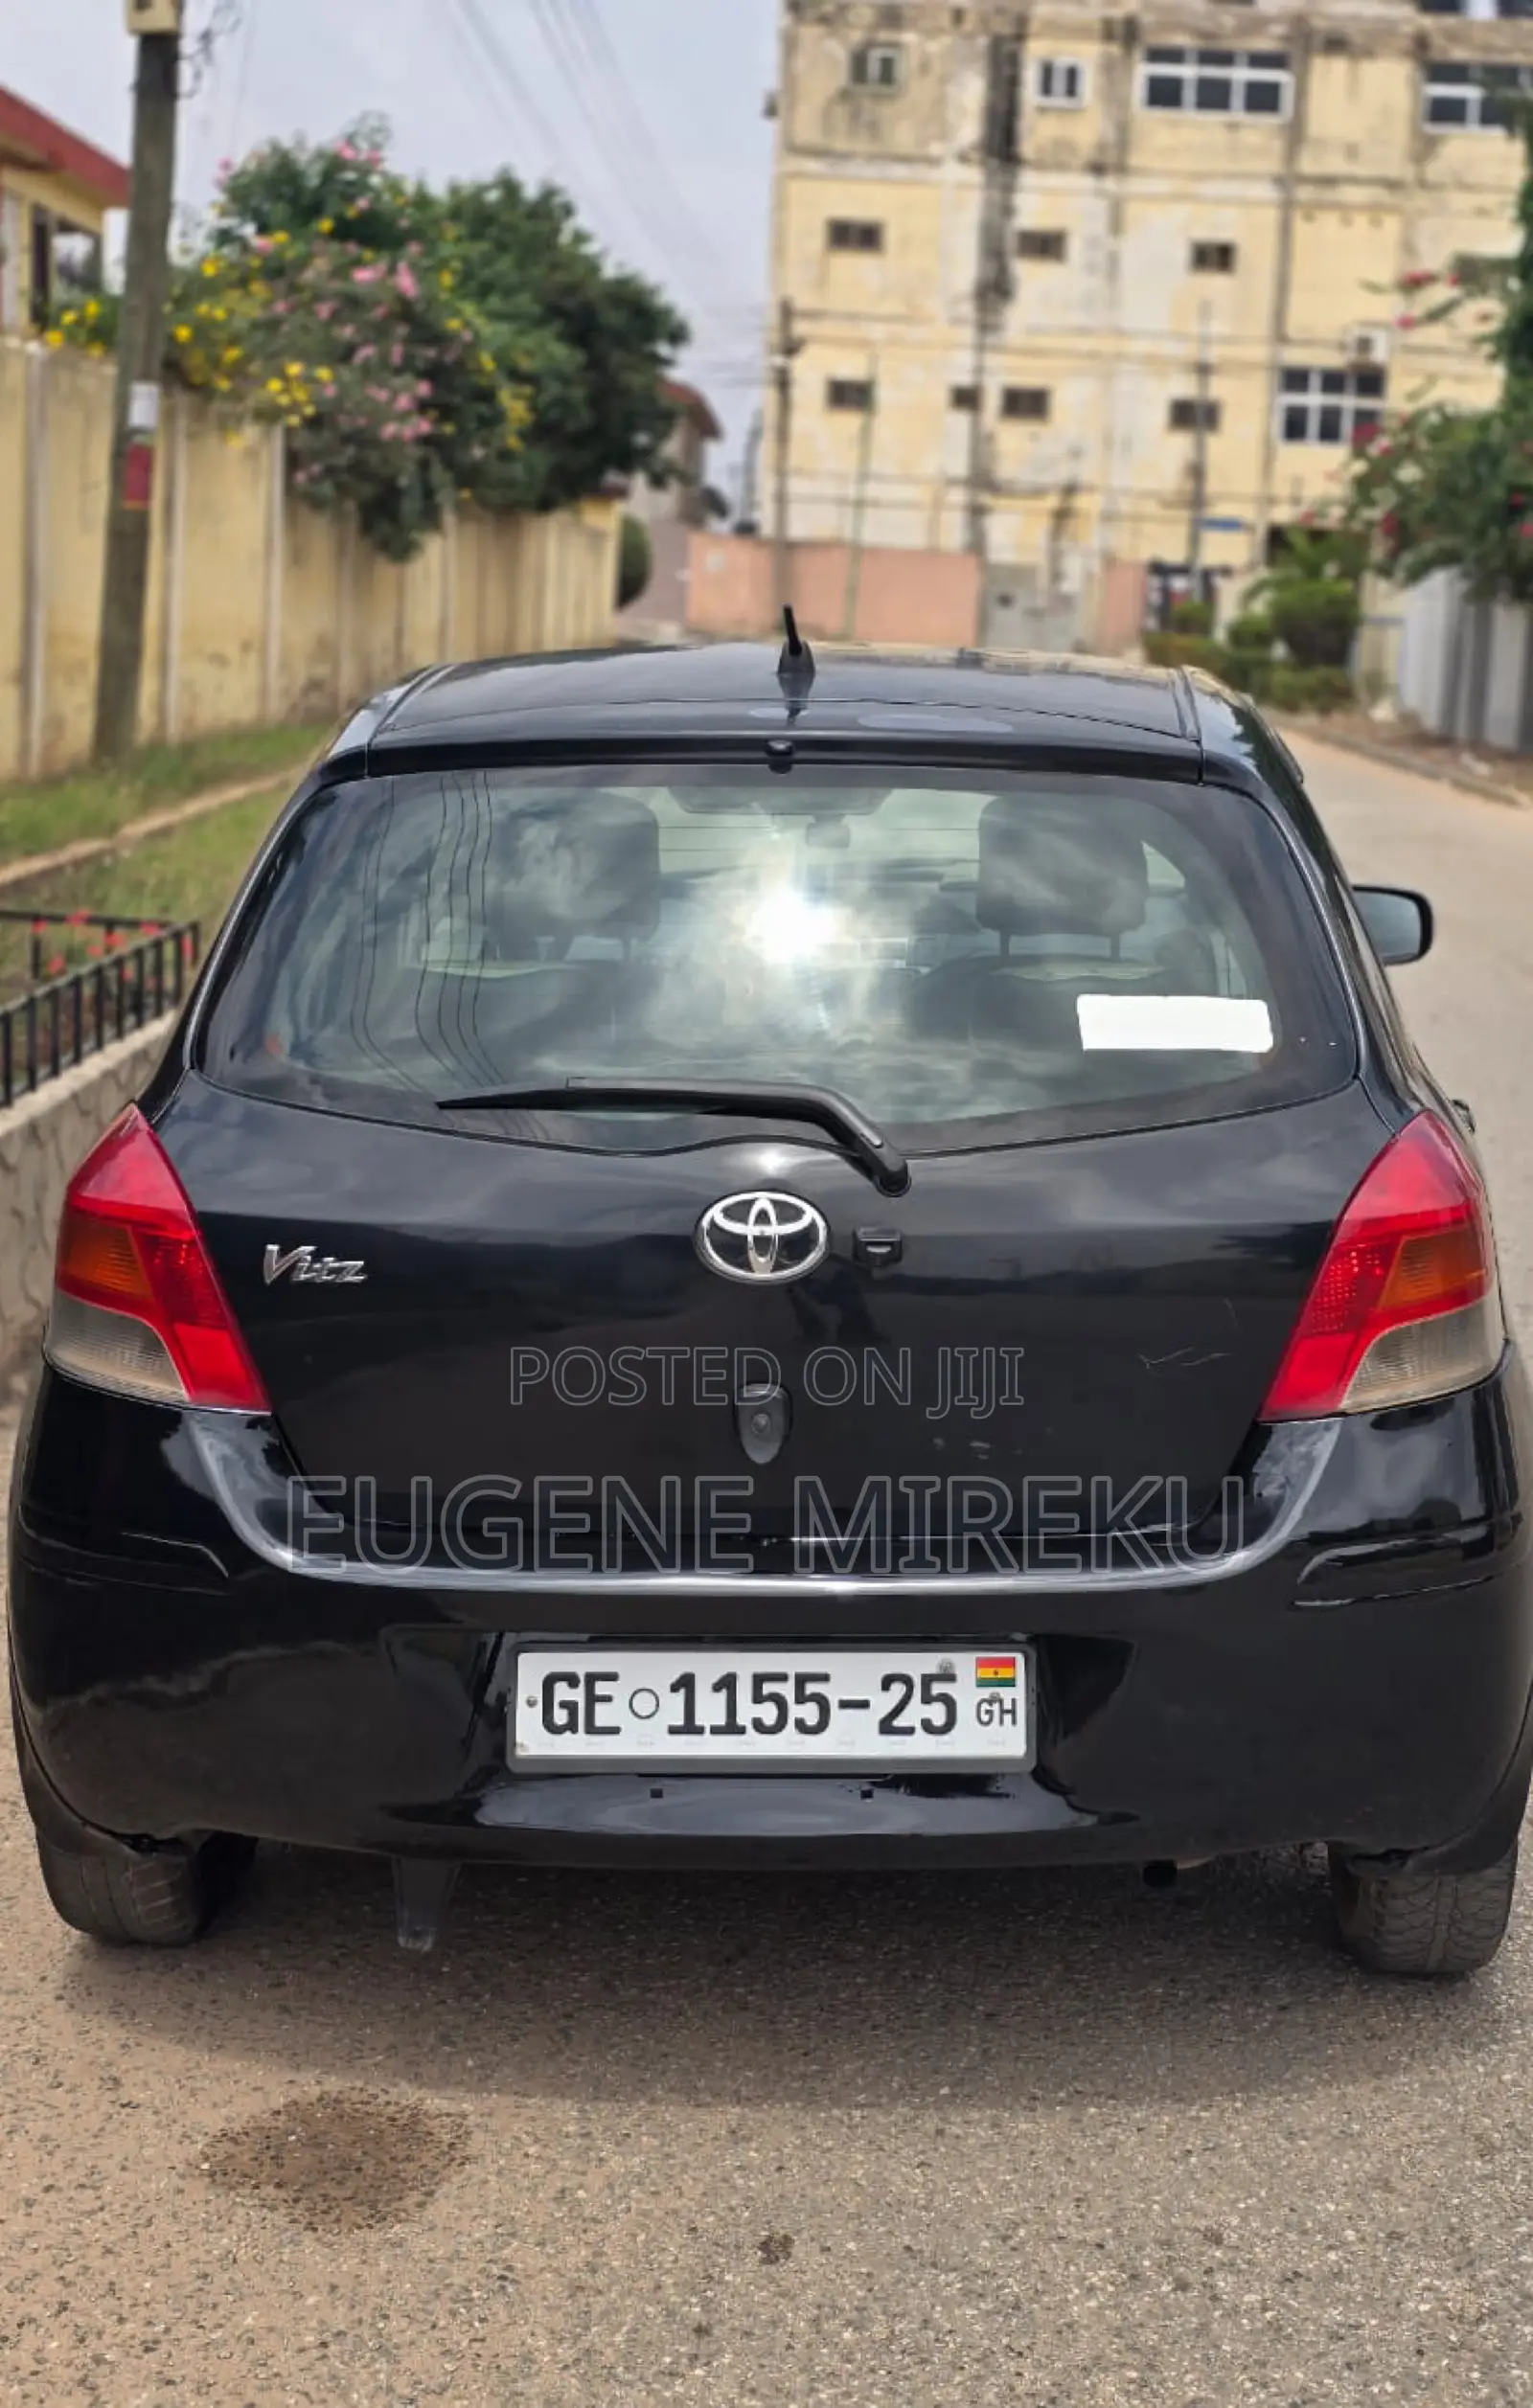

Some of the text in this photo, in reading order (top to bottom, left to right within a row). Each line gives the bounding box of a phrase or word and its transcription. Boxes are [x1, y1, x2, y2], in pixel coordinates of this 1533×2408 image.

[263, 1243, 367, 1285] Vitz
[541, 1671, 958, 1736] GE 1155-25
[975, 1697, 1018, 1726] GH
